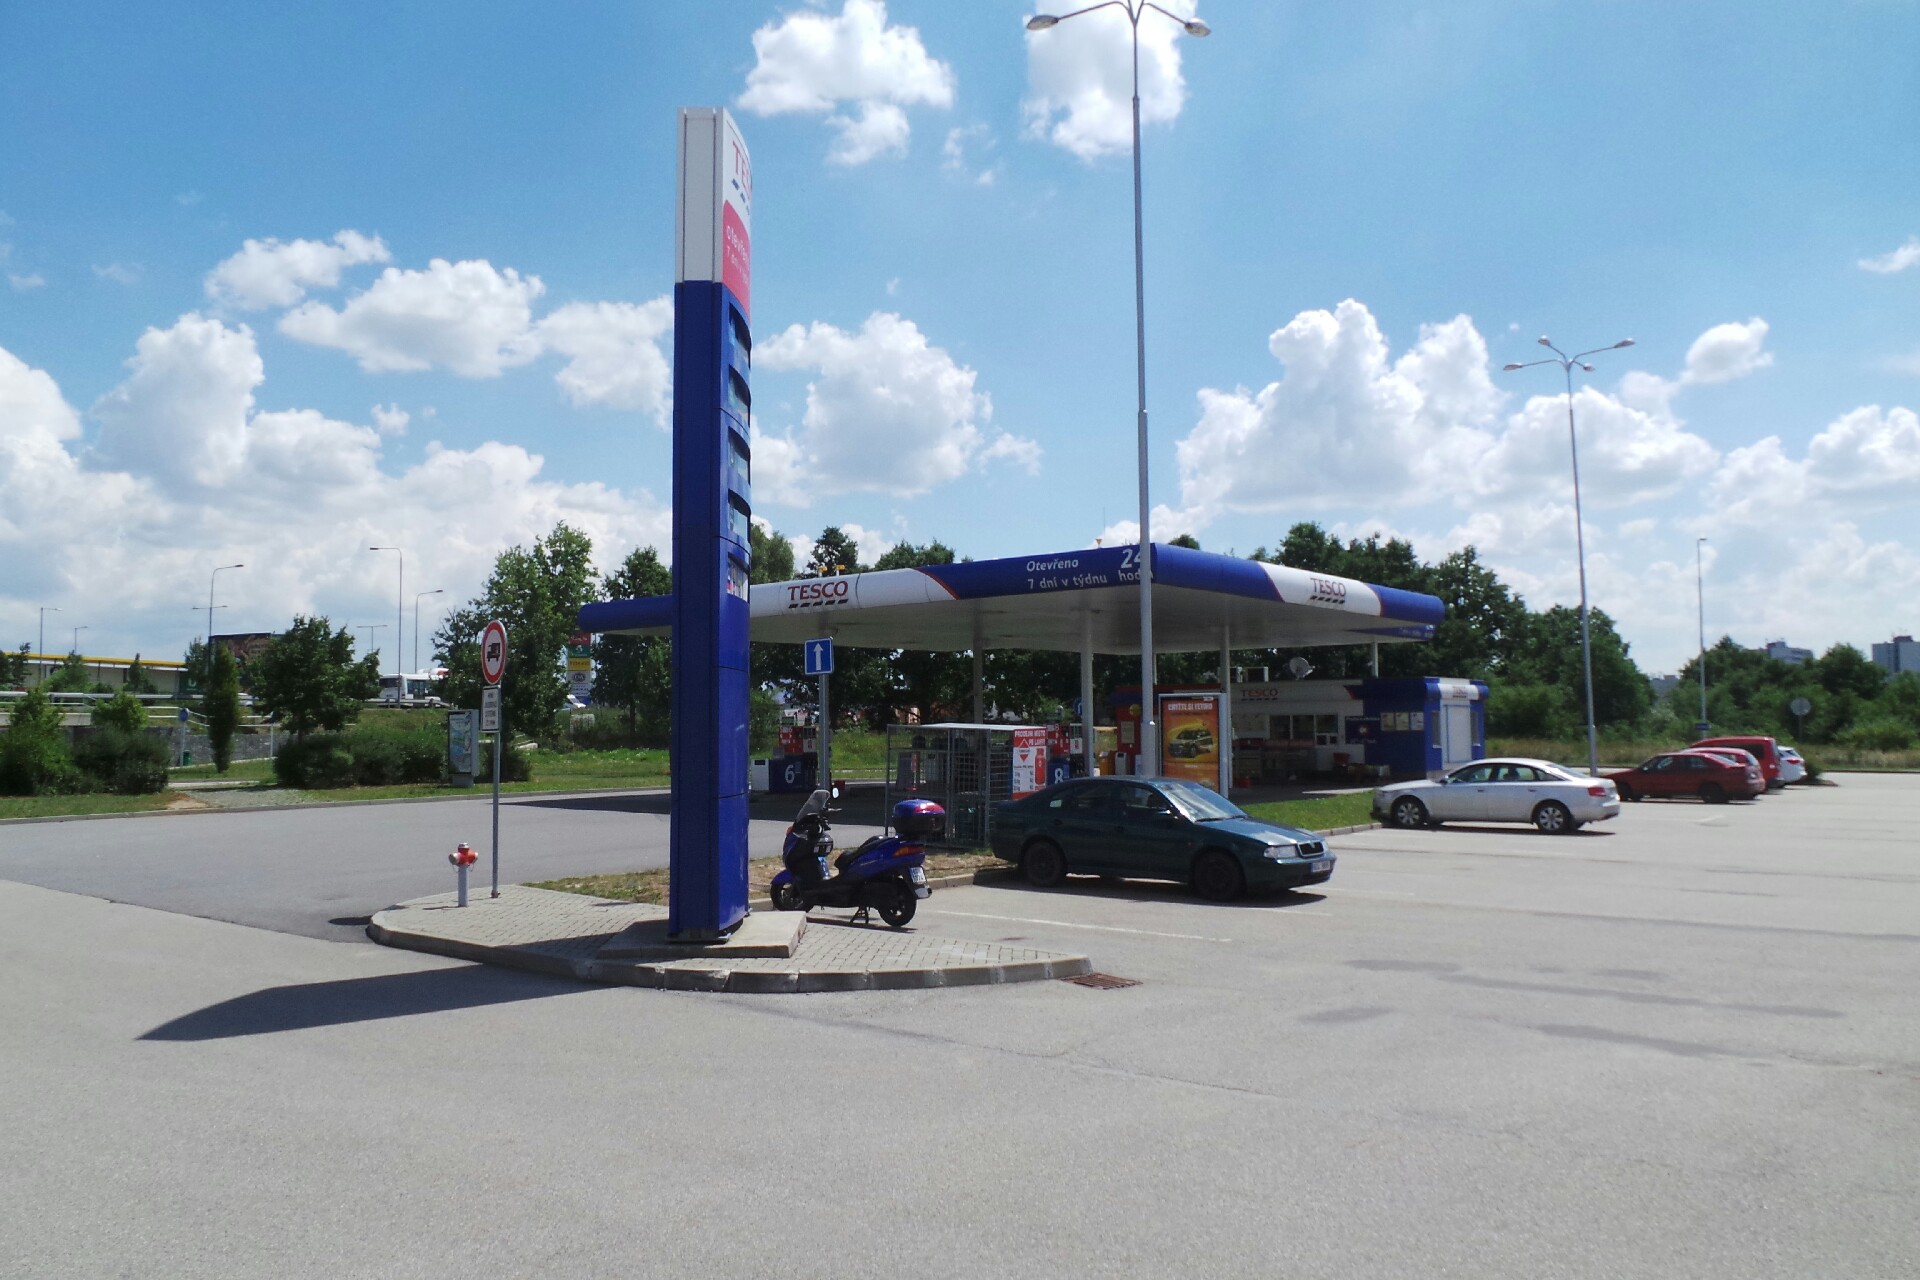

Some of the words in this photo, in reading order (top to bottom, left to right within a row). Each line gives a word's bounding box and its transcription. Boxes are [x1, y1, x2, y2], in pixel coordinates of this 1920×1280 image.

[1026, 558, 1079, 572] Otevřeno
[1027, 578, 1034, 590] 7
[1040, 576, 1058, 589] dní
[1060, 578, 1069, 587] v
[1072, 573, 1108, 588] týdnu
[1310, 577, 1347, 597] TESCO
[787, 580, 849, 601] TESCO
[1241, 688, 1279, 698] TESCO
[784, 764, 796, 784] 6
[1054, 767, 1064, 784] 8
